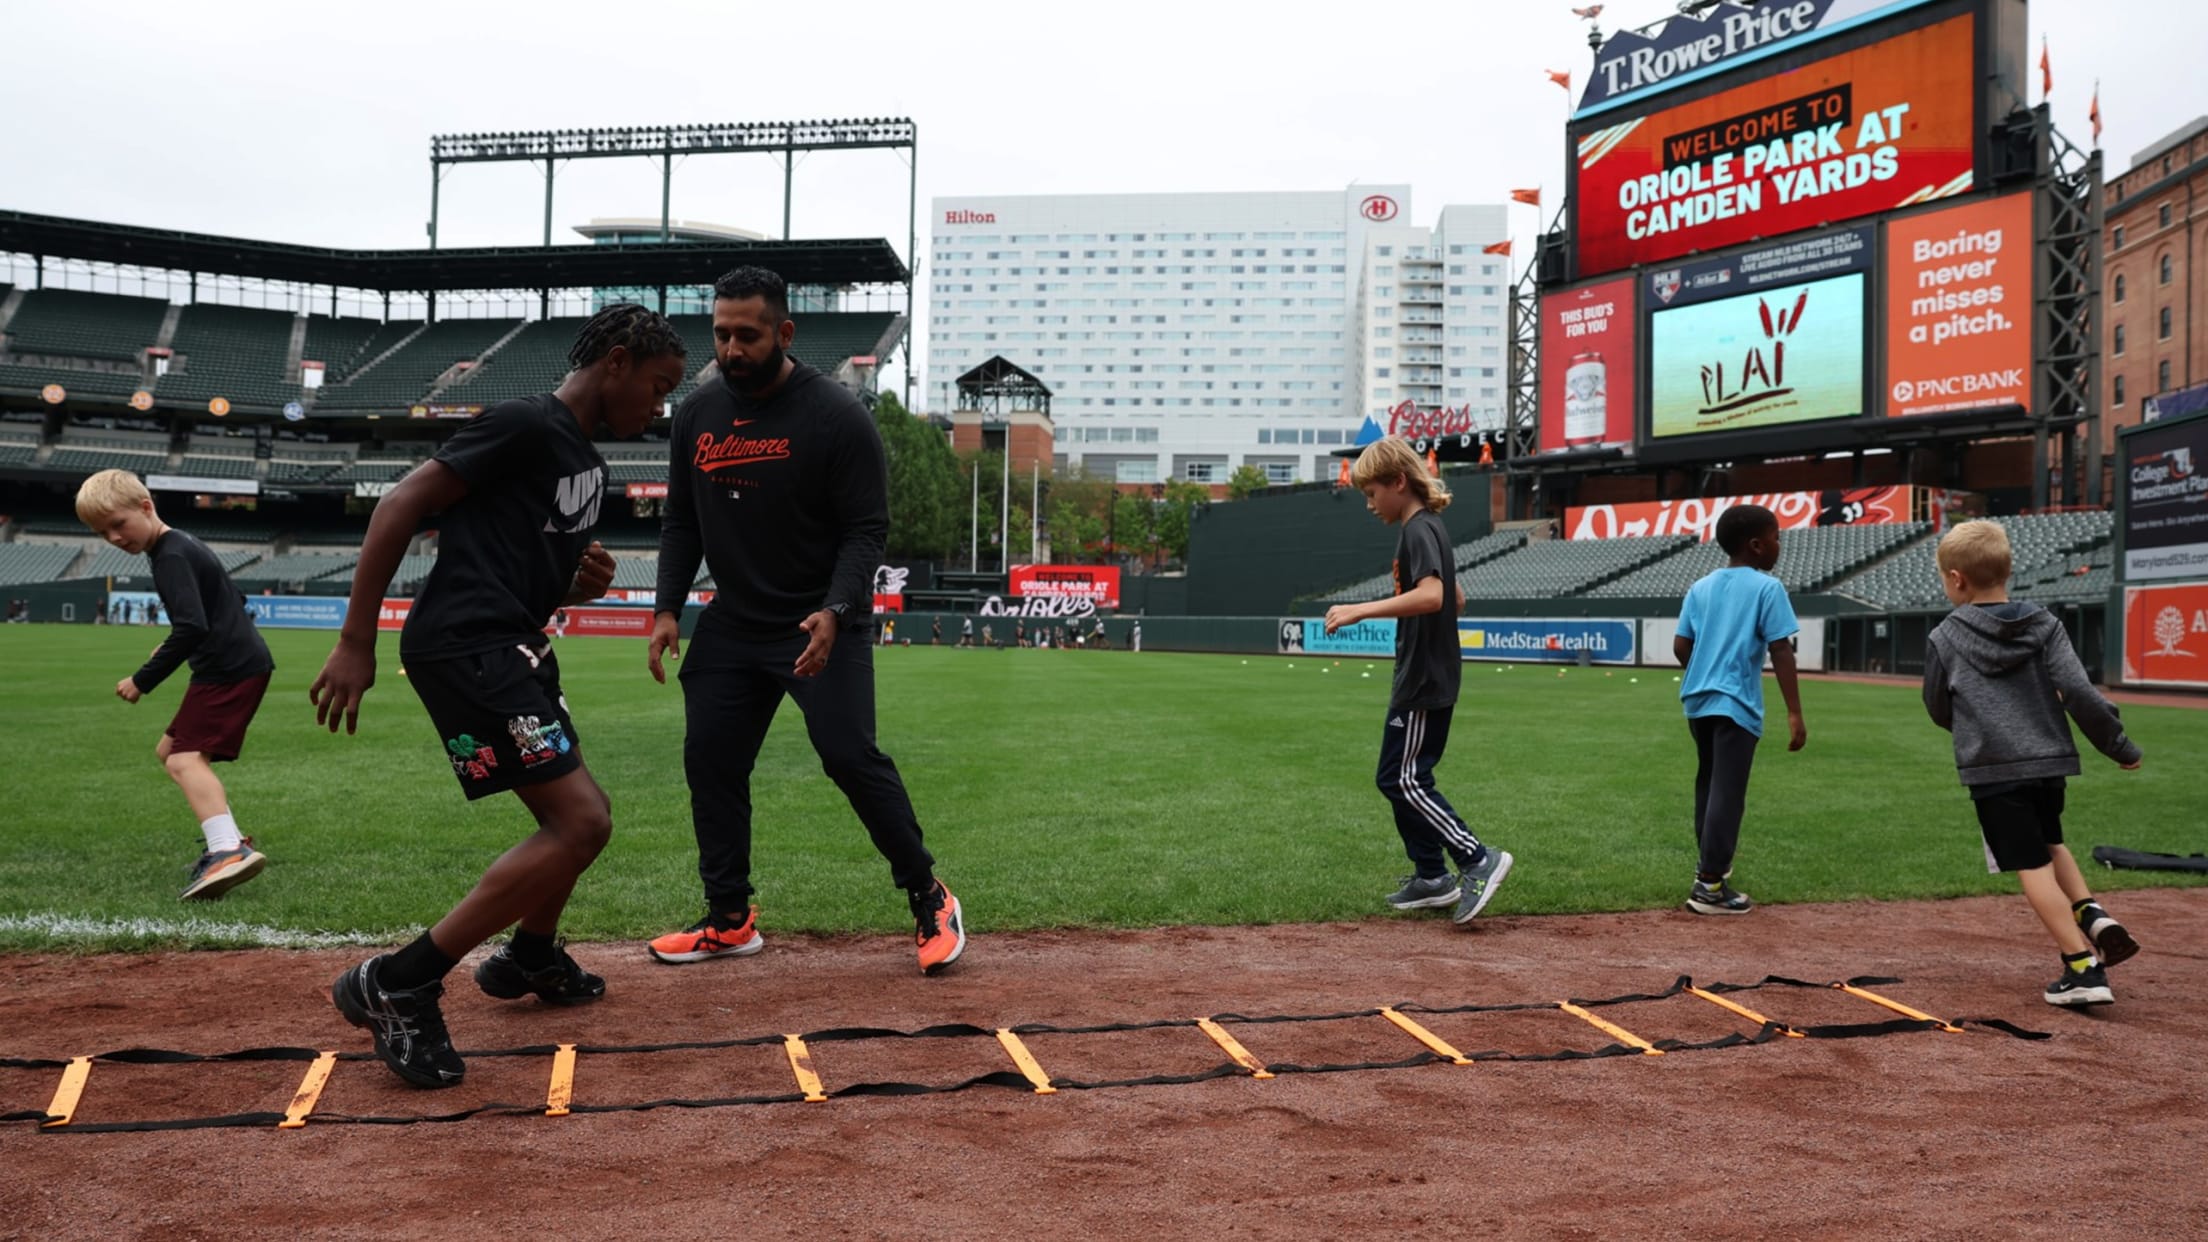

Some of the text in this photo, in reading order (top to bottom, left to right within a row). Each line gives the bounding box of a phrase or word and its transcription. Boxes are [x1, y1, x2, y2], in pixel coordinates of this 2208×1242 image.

[1671, 94, 1843, 162] WELCOME TO
[1619, 103, 1909, 210] ORIOLE PARK AT
[1626, 145, 1899, 240] CAMDEN YARDS
[946, 209, 996, 224] Hilton
[1913, 229, 2003, 262] Boring
[1919, 258, 1997, 288] never
[1560, 302, 1614, 325] THIS BUD'S
[1911, 284, 2004, 317] misses
[1566, 319, 1608, 338] FOR YOU
[1909, 308, 2012, 345] a pitch.
[1388, 399, 1472, 440] Coors
[693, 432, 790, 472] Baltimore
[2131, 465, 2169, 483] College
[2131, 481, 2189, 501] Investment
[1020, 580, 1109, 592] ORIOLE PARK AT
